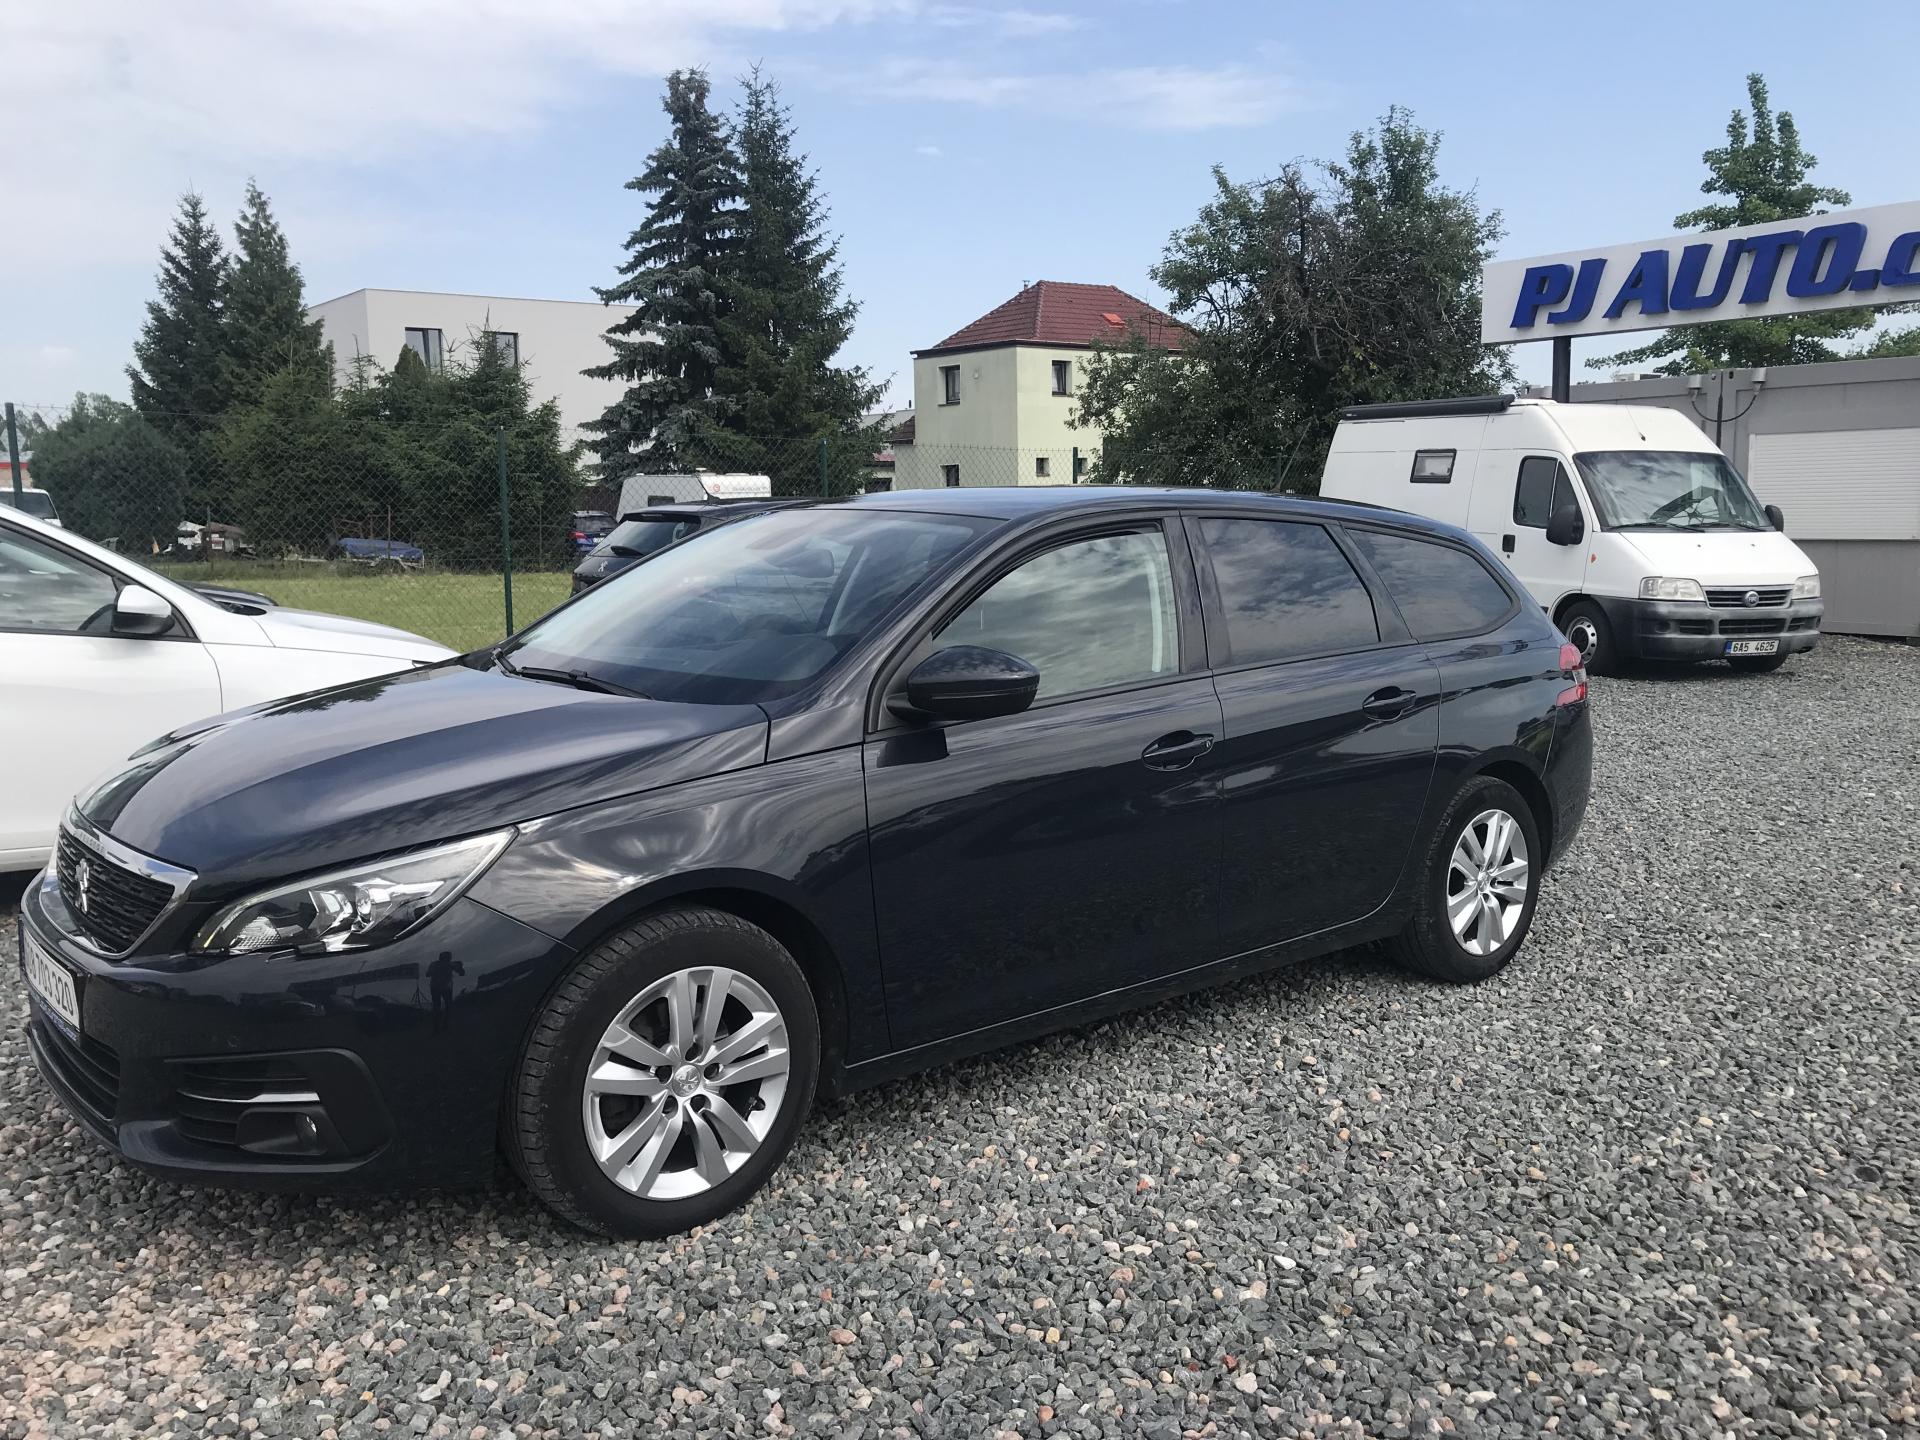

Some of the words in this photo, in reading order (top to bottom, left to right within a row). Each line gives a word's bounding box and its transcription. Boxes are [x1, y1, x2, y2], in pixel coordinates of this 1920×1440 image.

[1510, 257, 1608, 329] PJ
[1733, 643, 1749, 652] 6A5
[1755, 641, 1775, 651] 4625
